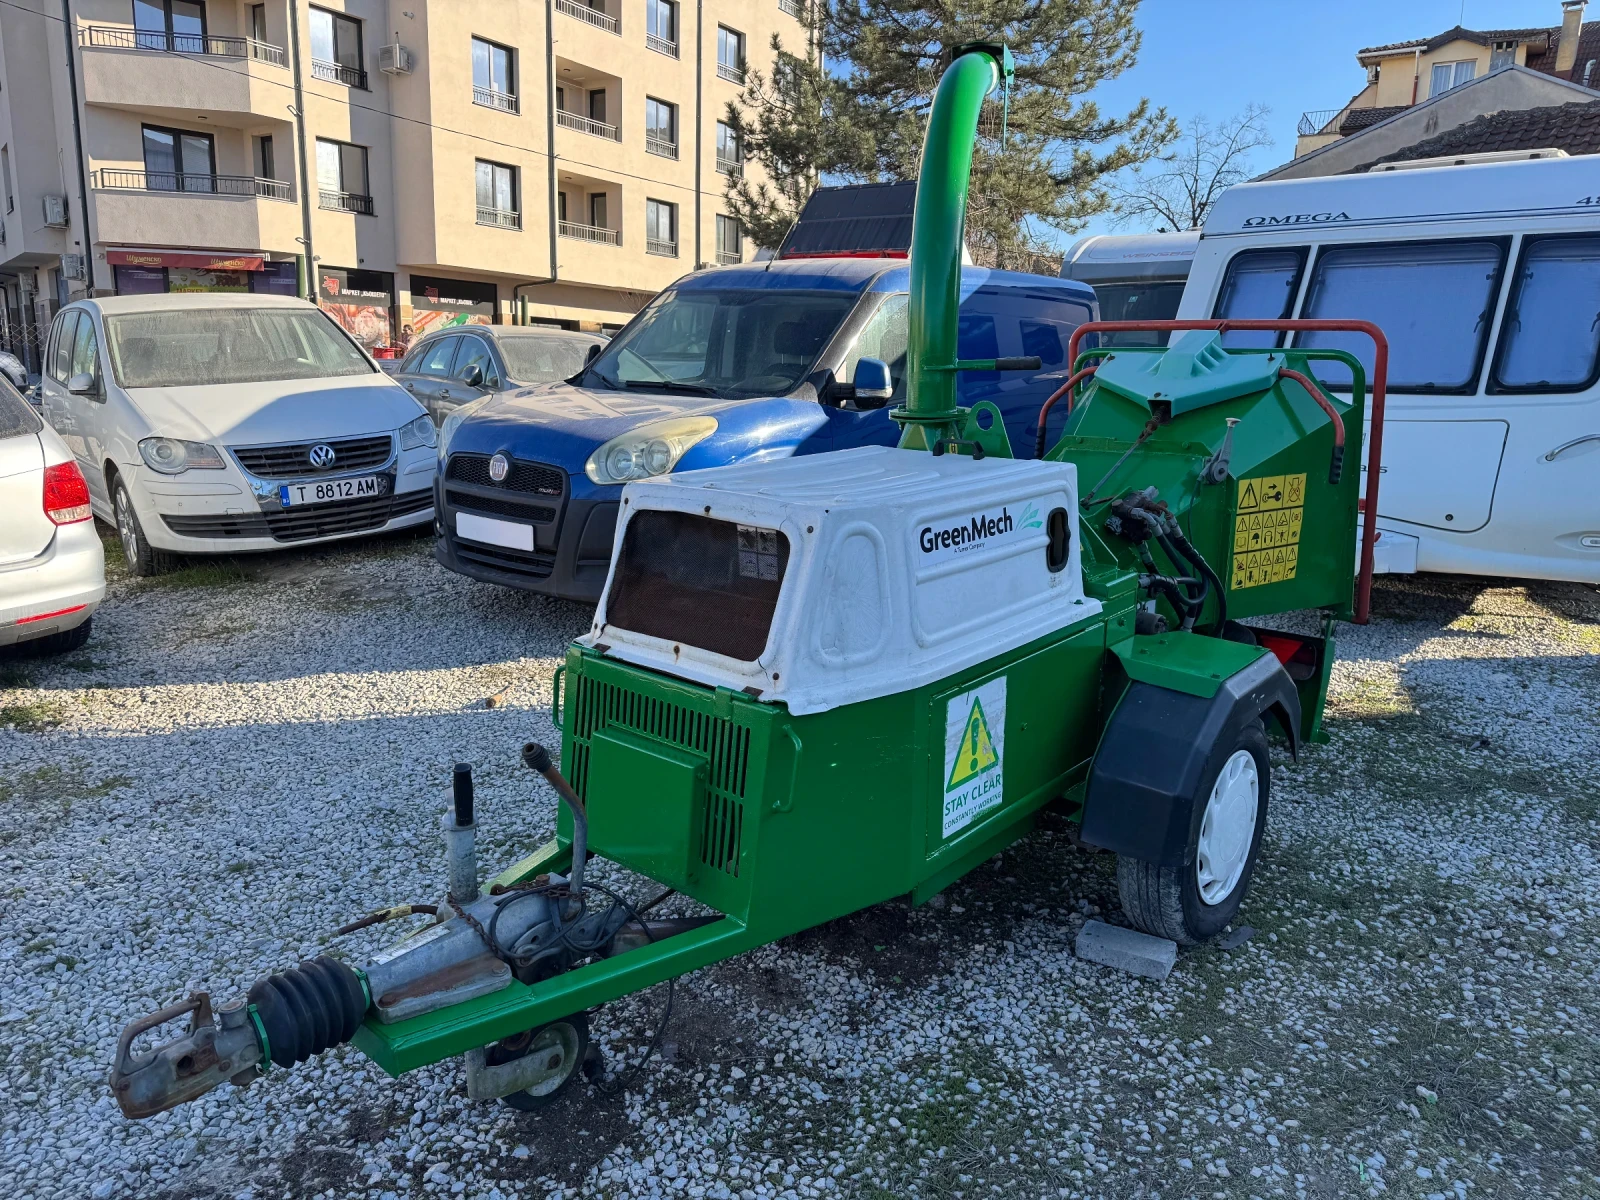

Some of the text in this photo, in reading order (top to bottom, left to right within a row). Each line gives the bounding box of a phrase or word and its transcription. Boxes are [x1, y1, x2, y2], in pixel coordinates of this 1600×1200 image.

[126, 254, 162, 265] Шуменско
[210, 258, 246, 269] Шуменско
[1123, 250, 1196, 259] WEINSBE
[296, 478, 376, 502] T 8812 AM
[920, 507, 1013, 554] GreenMech
[945, 773, 1001, 817] STAY CLEAR
[944, 791, 1002, 830] CONSTANTLY WORKING
